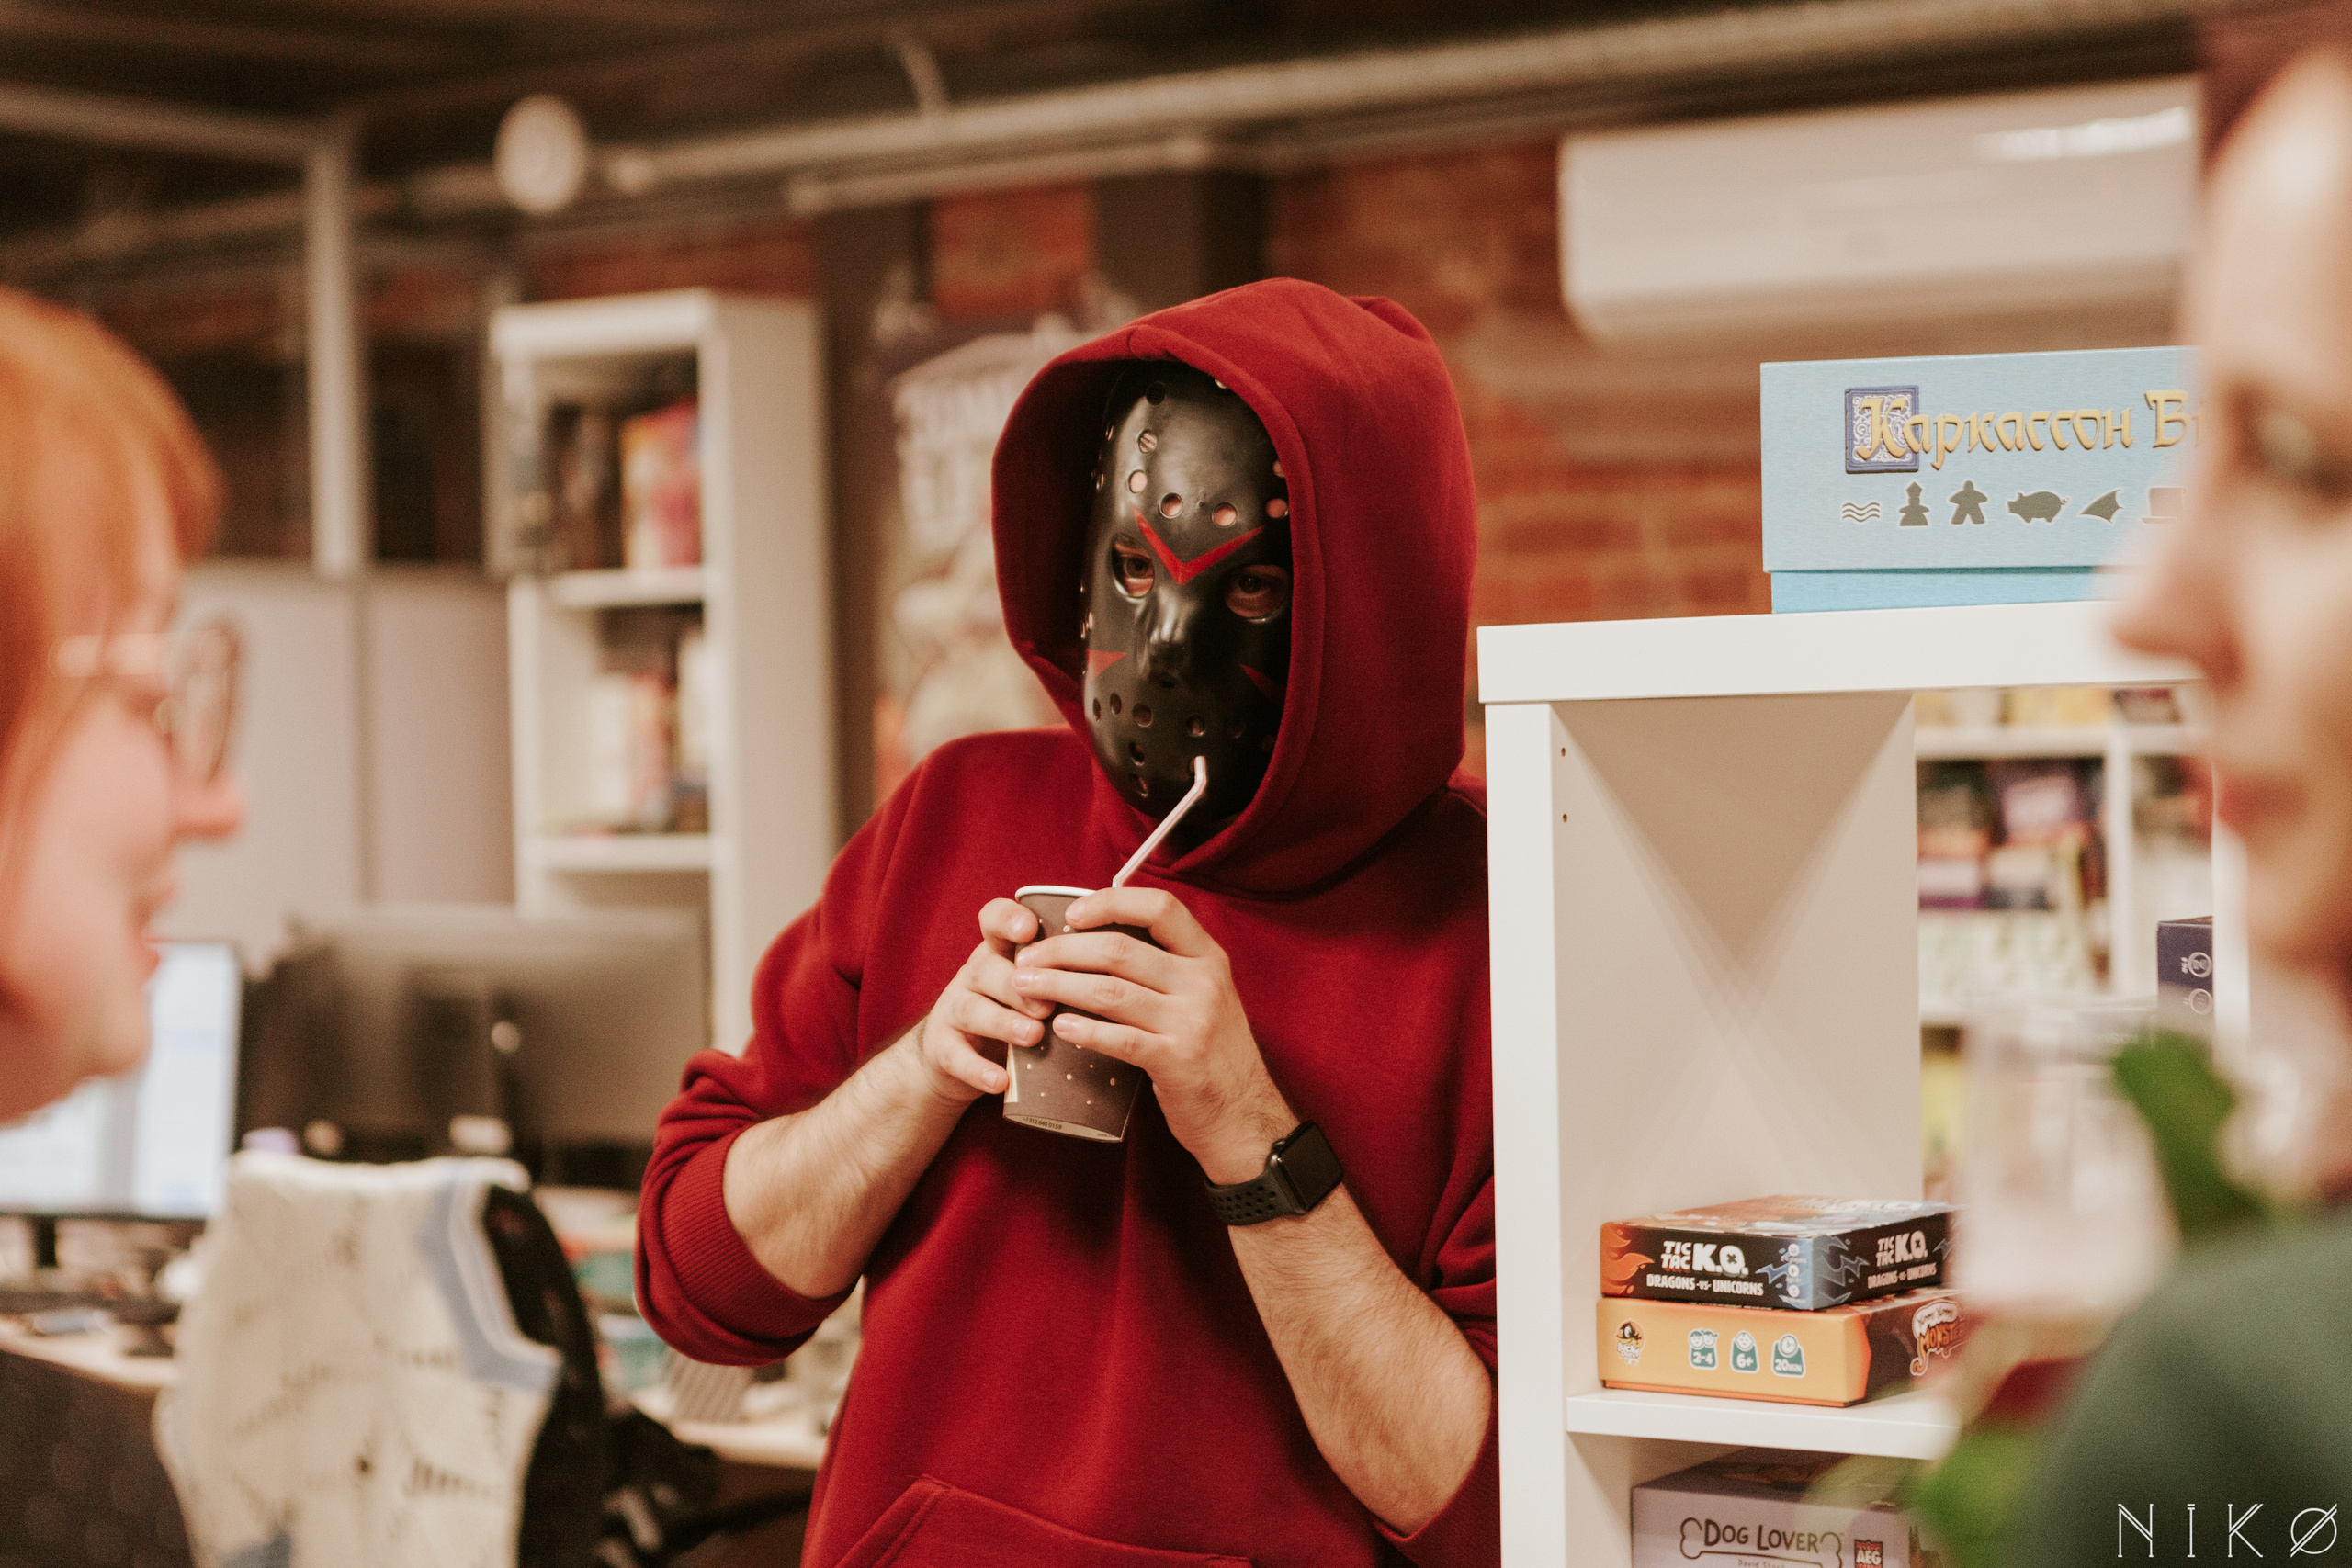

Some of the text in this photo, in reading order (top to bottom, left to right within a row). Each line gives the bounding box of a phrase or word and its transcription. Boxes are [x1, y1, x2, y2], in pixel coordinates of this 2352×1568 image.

[1857, 397, 2134, 470] Каркассон
[1663, 1240, 1692, 1256] TIC
[1877, 1235, 1894, 1251] TIC
[1895, 1230, 1928, 1263] K.O.
[1661, 1254, 1690, 1269] TAC
[1692, 1242, 1749, 1276] K.O.
[1876, 1250, 1894, 1267] TAC
[1646, 1273, 1696, 1291] DRAGONS
[1713, 1279, 1764, 1297] UNICORNS
[1692, 1351, 1713, 1366] 2-4
[1736, 1353, 1754, 1368] 6+
[1856, 1550, 1882, 1566] AEG
